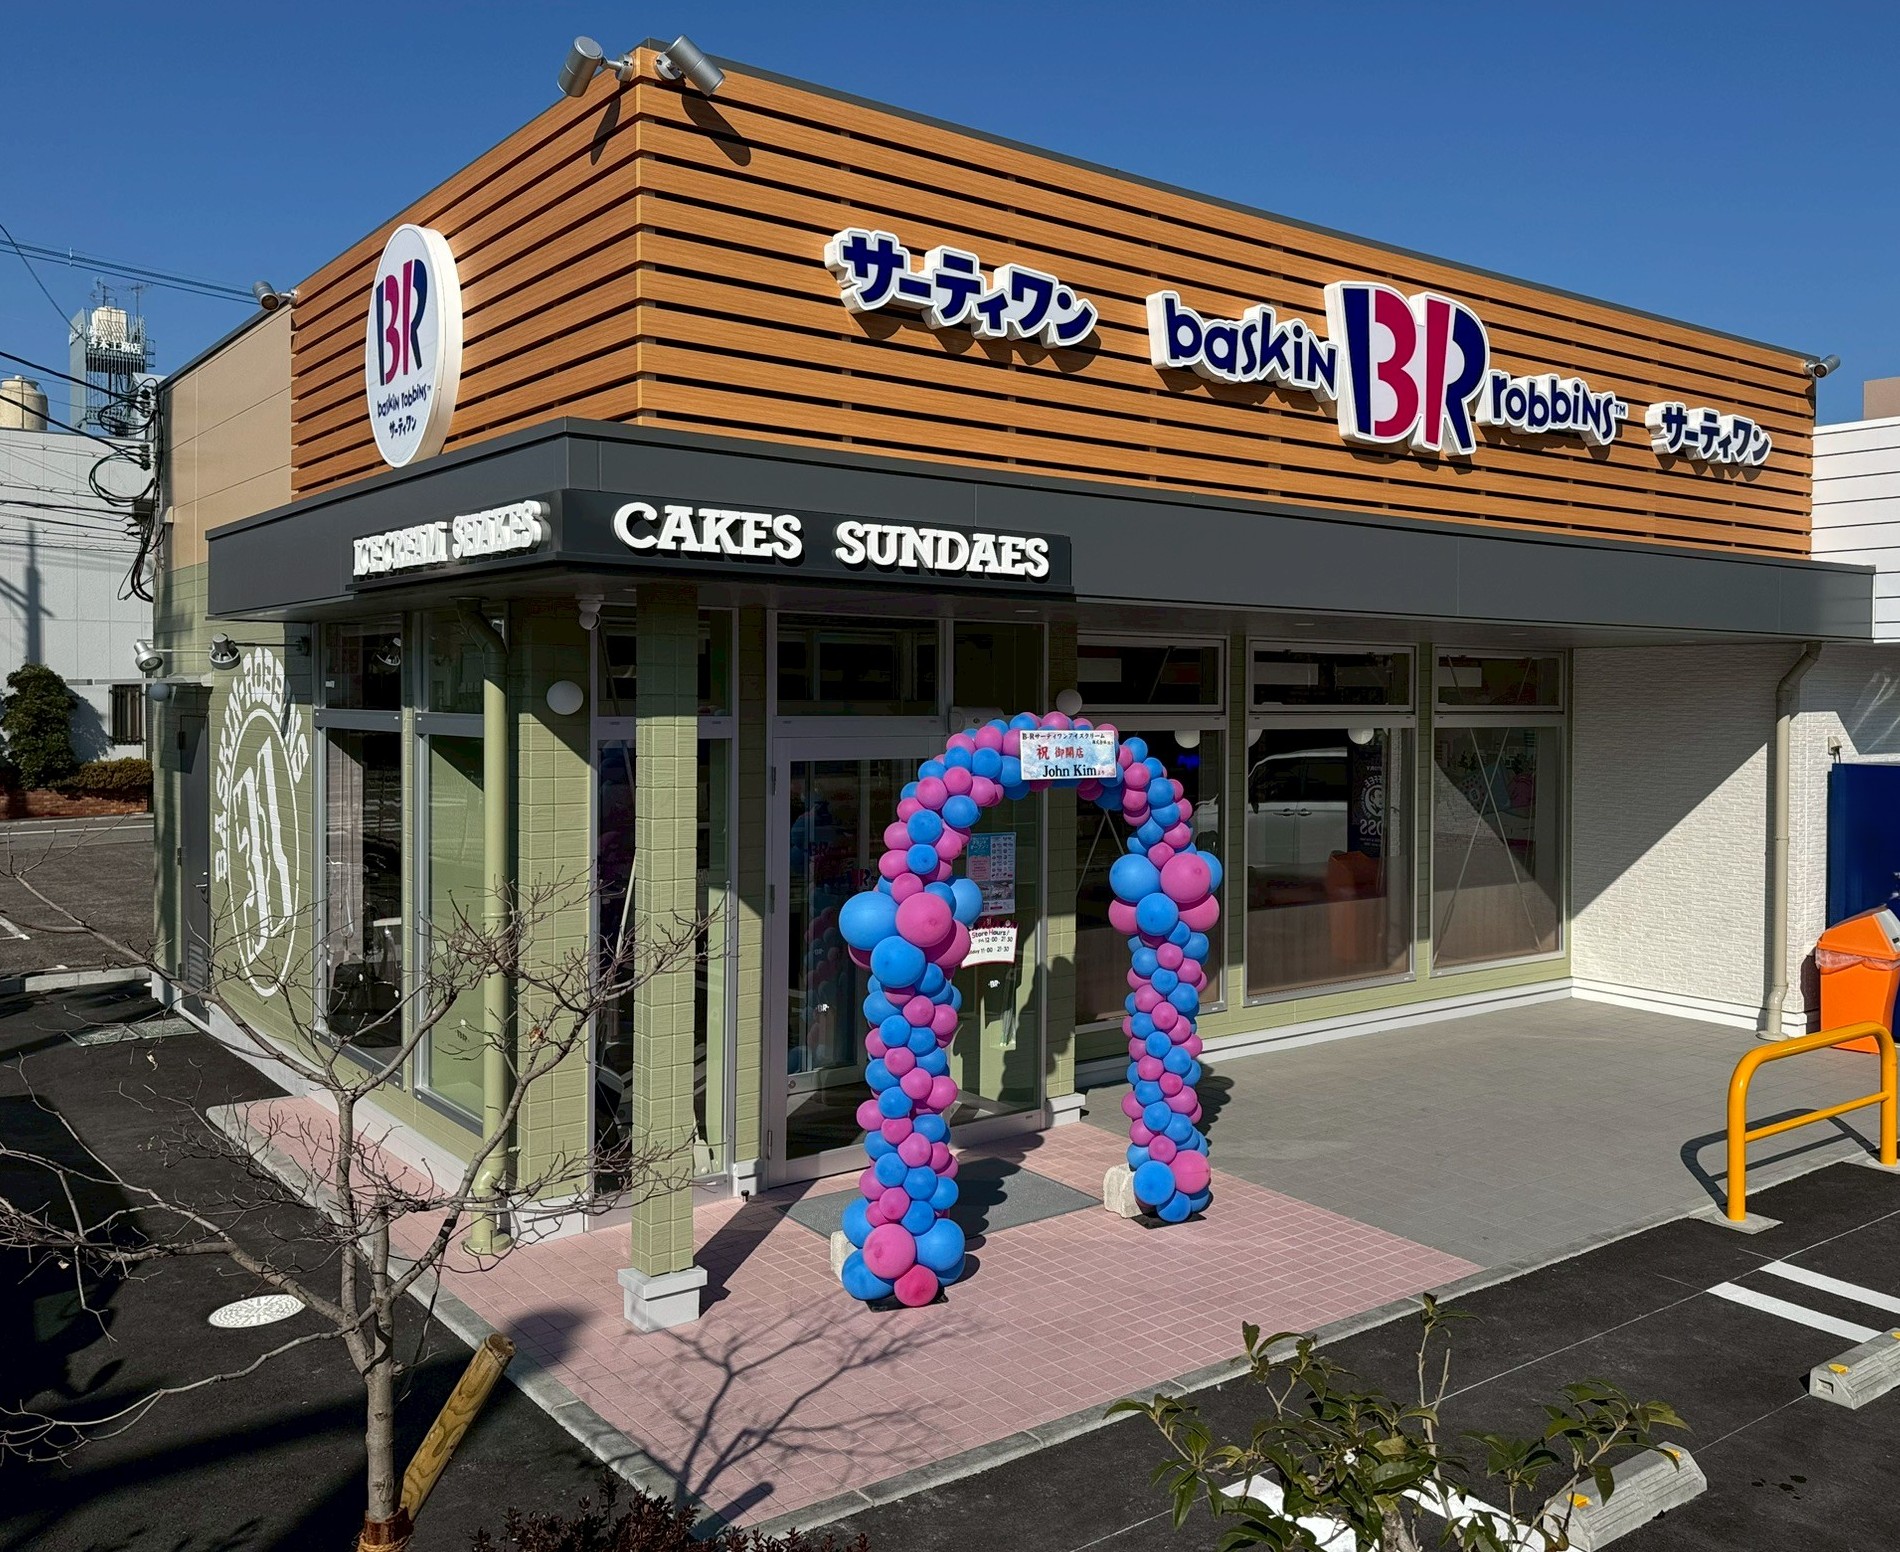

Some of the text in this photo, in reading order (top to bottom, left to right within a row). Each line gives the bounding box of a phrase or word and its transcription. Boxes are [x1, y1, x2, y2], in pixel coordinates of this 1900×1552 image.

[843, 236, 1092, 339] サーティワン
[376, 259, 427, 386] BR
[1164, 297, 1337, 394] baskin
[1343, 288, 1486, 449] BR
[378, 393, 400, 418] baskin
[389, 415, 417, 439] サーティワン
[1662, 405, 1769, 461] サーティワン
[452, 500, 542, 559] SHAKES
[613, 502, 1050, 578] CAKES SUNDAES
[1036, 745, 1049, 760] 祝
[1042, 765, 1070, 777] John
[1073, 764, 1097, 776] Kim
